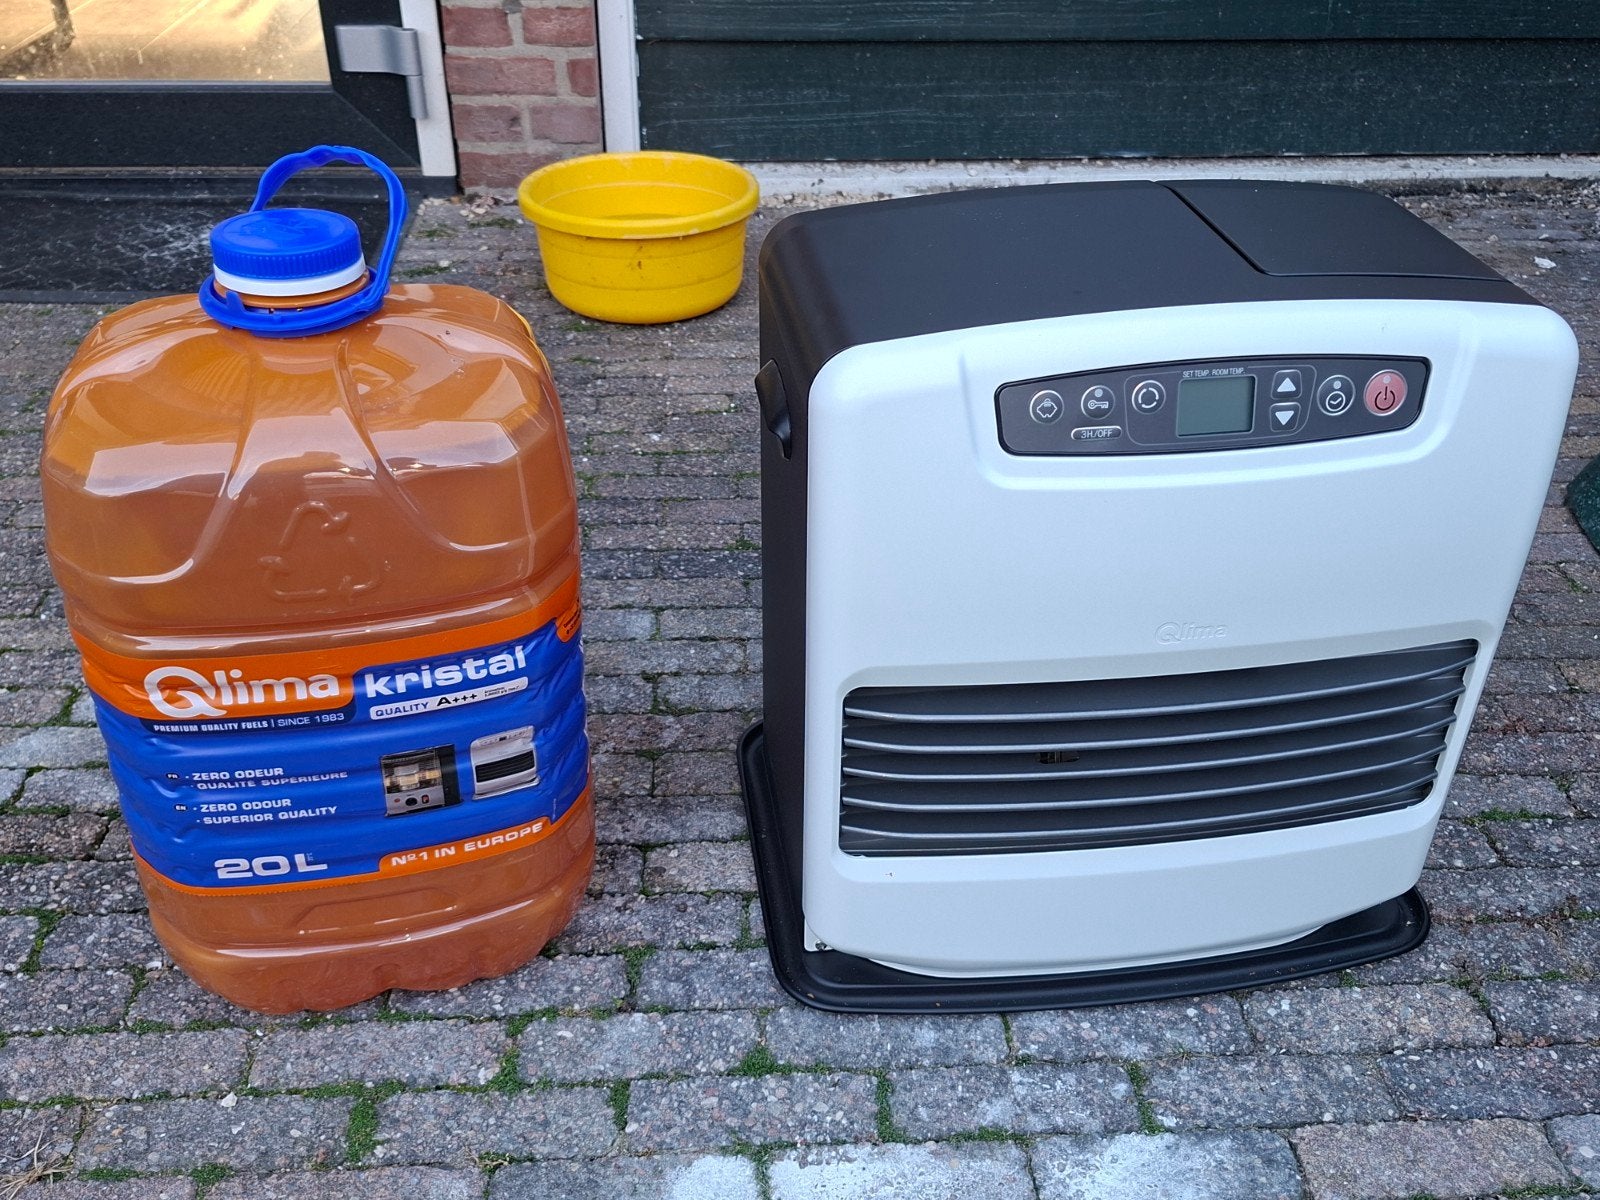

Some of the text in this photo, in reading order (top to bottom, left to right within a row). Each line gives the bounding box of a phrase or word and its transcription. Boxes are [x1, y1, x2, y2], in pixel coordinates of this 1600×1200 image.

[1182, 370, 1193, 378] SET
[1211, 368, 1228, 376] ROOM
[1155, 621, 1228, 645] Qlima
[364, 645, 527, 698] kristal
[143, 665, 340, 718] Qlima
[375, 693, 478, 717] QUALITY A+++
[153, 721, 268, 732] PREMIUM QUALITY FUELS
[277, 712, 345, 727] SINCE 1983
[192, 767, 284, 781] ZERO ODEUR
[200, 799, 292, 813] ZERO ODOUR
[203, 806, 338, 825] SUPERIOR QUALITY
[434, 845, 456, 858] IN
[464, 822, 543, 852] EUROPE
